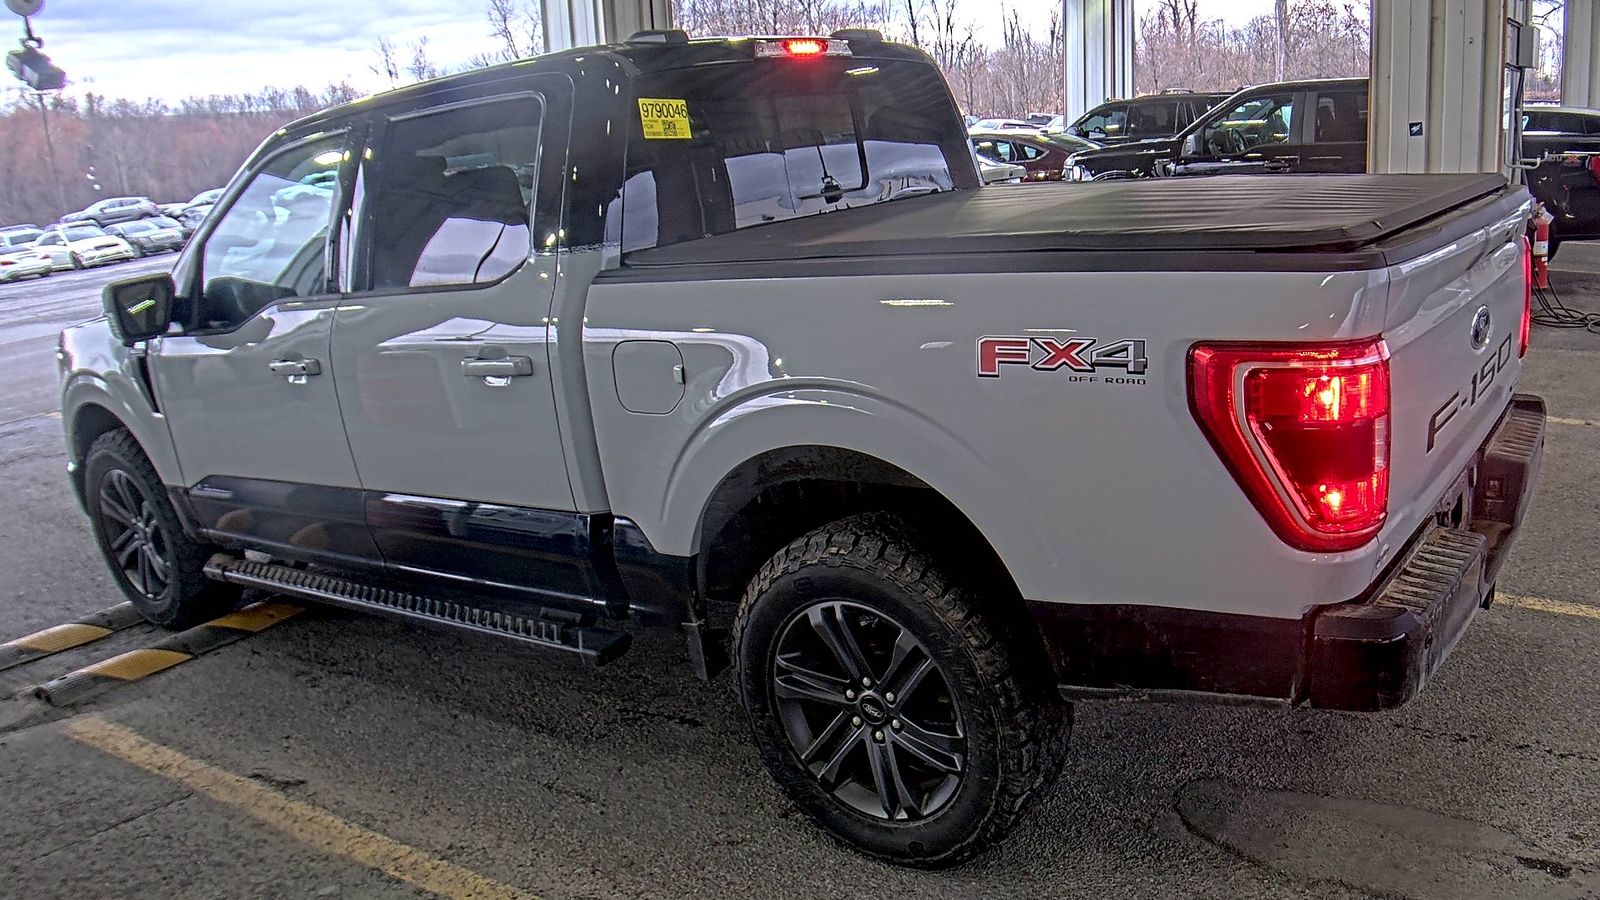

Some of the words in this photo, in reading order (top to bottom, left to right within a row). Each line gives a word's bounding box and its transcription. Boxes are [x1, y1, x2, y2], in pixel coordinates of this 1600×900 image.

[641, 103, 688, 118] 9790046
[977, 336, 1148, 378] FX4
[1068, 375, 1099, 383] OFF
[1104, 377, 1147, 385] ROAD
[1426, 333, 1512, 454] F-150
